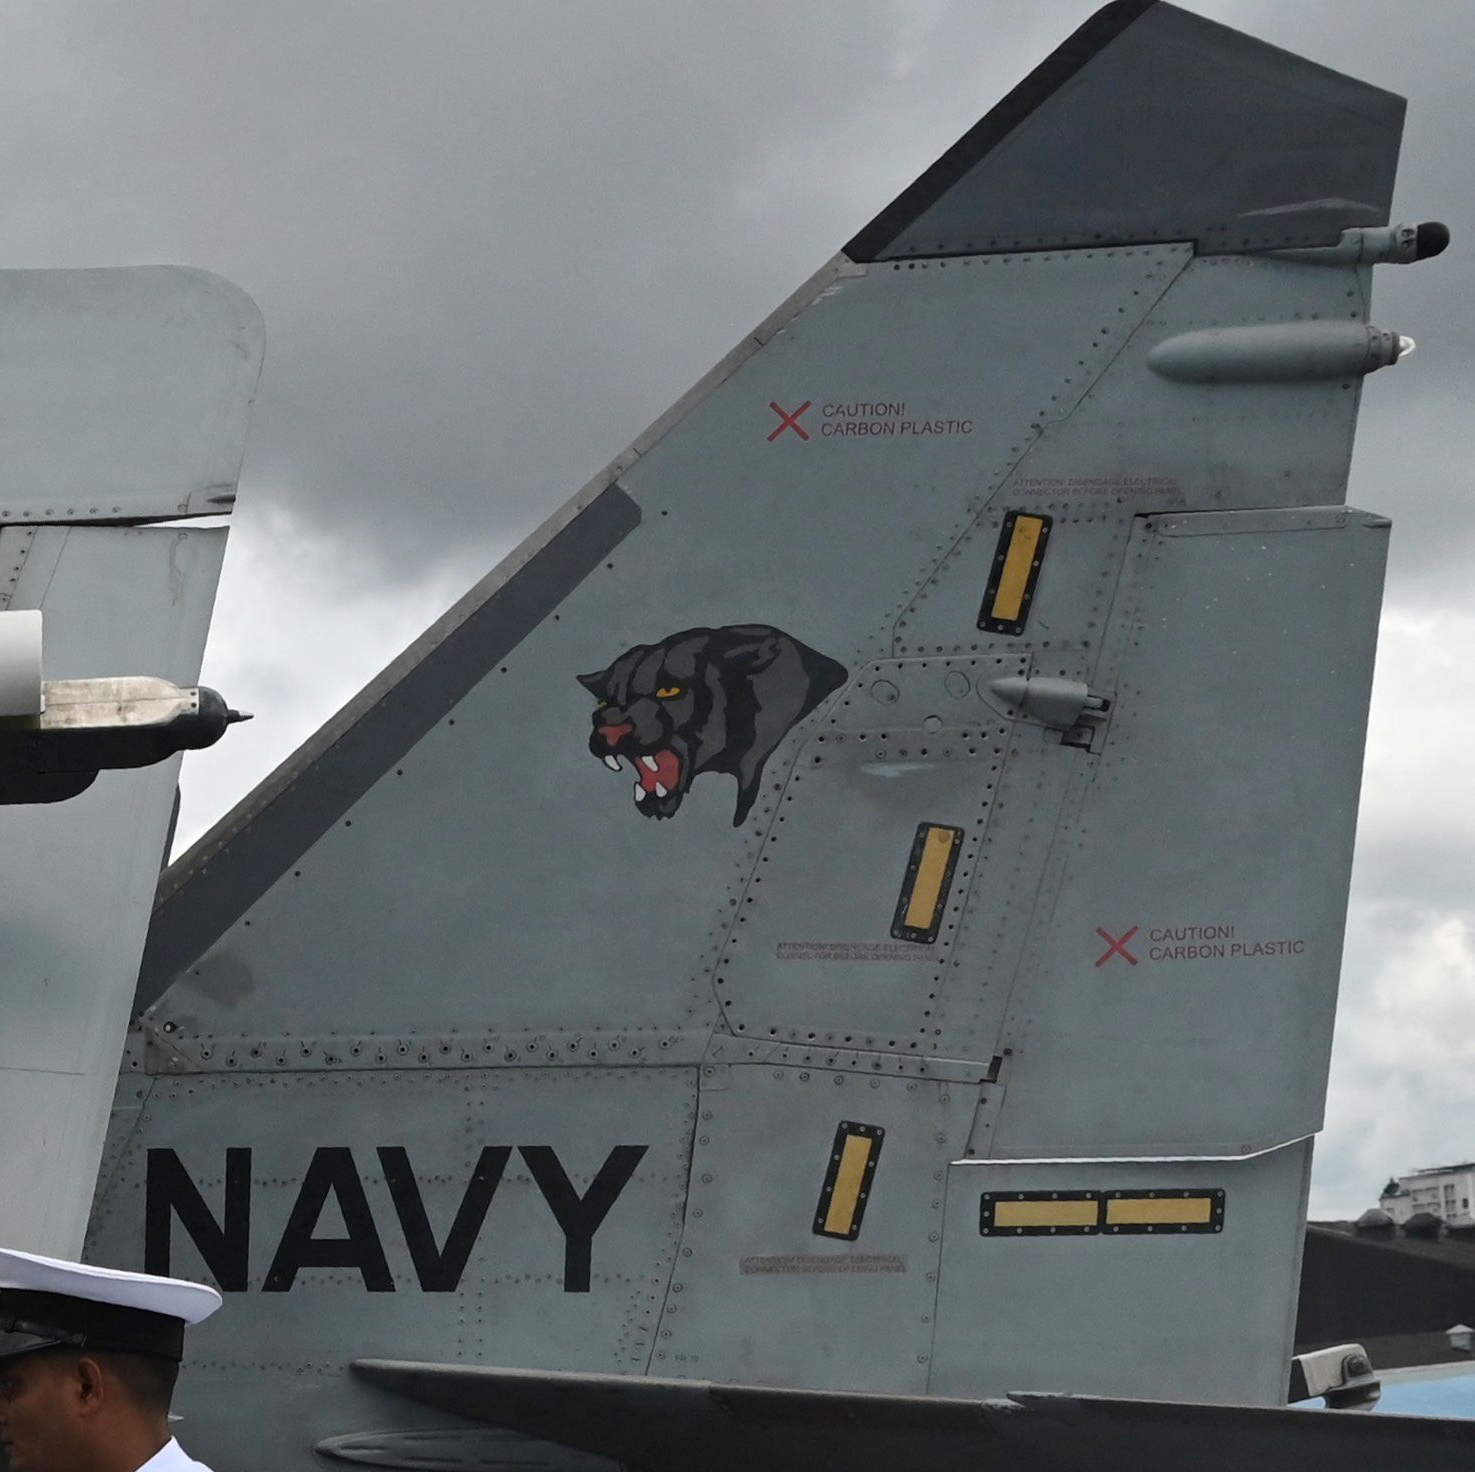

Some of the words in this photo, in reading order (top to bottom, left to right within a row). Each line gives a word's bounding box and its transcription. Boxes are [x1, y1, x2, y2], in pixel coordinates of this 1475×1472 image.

[821, 402, 907, 418] CAUTION!
[820, 421, 896, 437] CARBON
[900, 419, 974, 435] PLASTIC
[1149, 944, 1225, 961] CARBON
[1230, 940, 1306, 957] PLASTIC
[145, 1145, 649, 1293] NAVY
